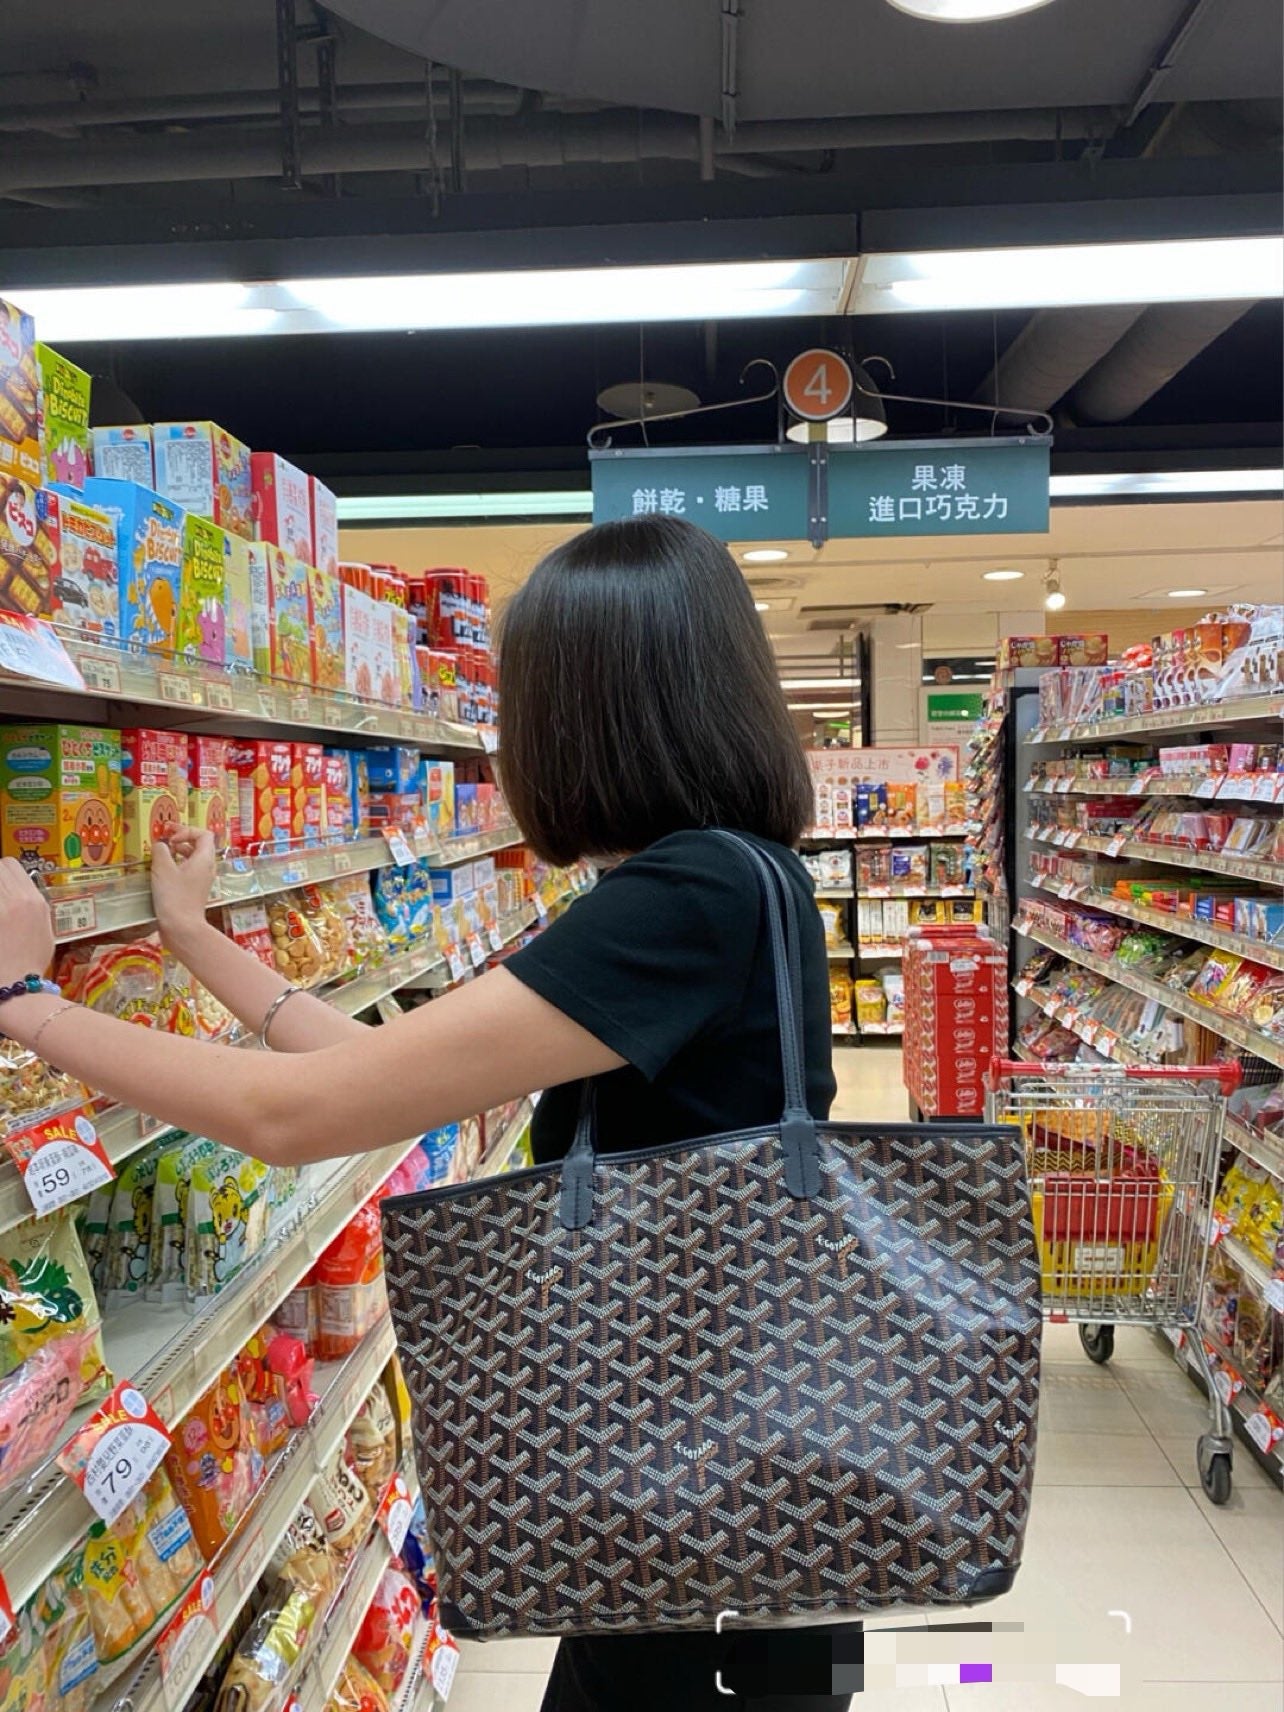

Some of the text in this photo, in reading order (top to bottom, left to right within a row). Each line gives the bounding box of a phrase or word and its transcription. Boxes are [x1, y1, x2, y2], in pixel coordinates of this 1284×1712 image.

[803, 364, 832, 404] 4
[911, 463, 966, 492] 果凍
[868, 492, 1008, 522] 進口巧克力
[44, 1125, 78, 1141] SALE
[42, 1168, 70, 1193] 59
[101, 1458, 132, 1494] 79
